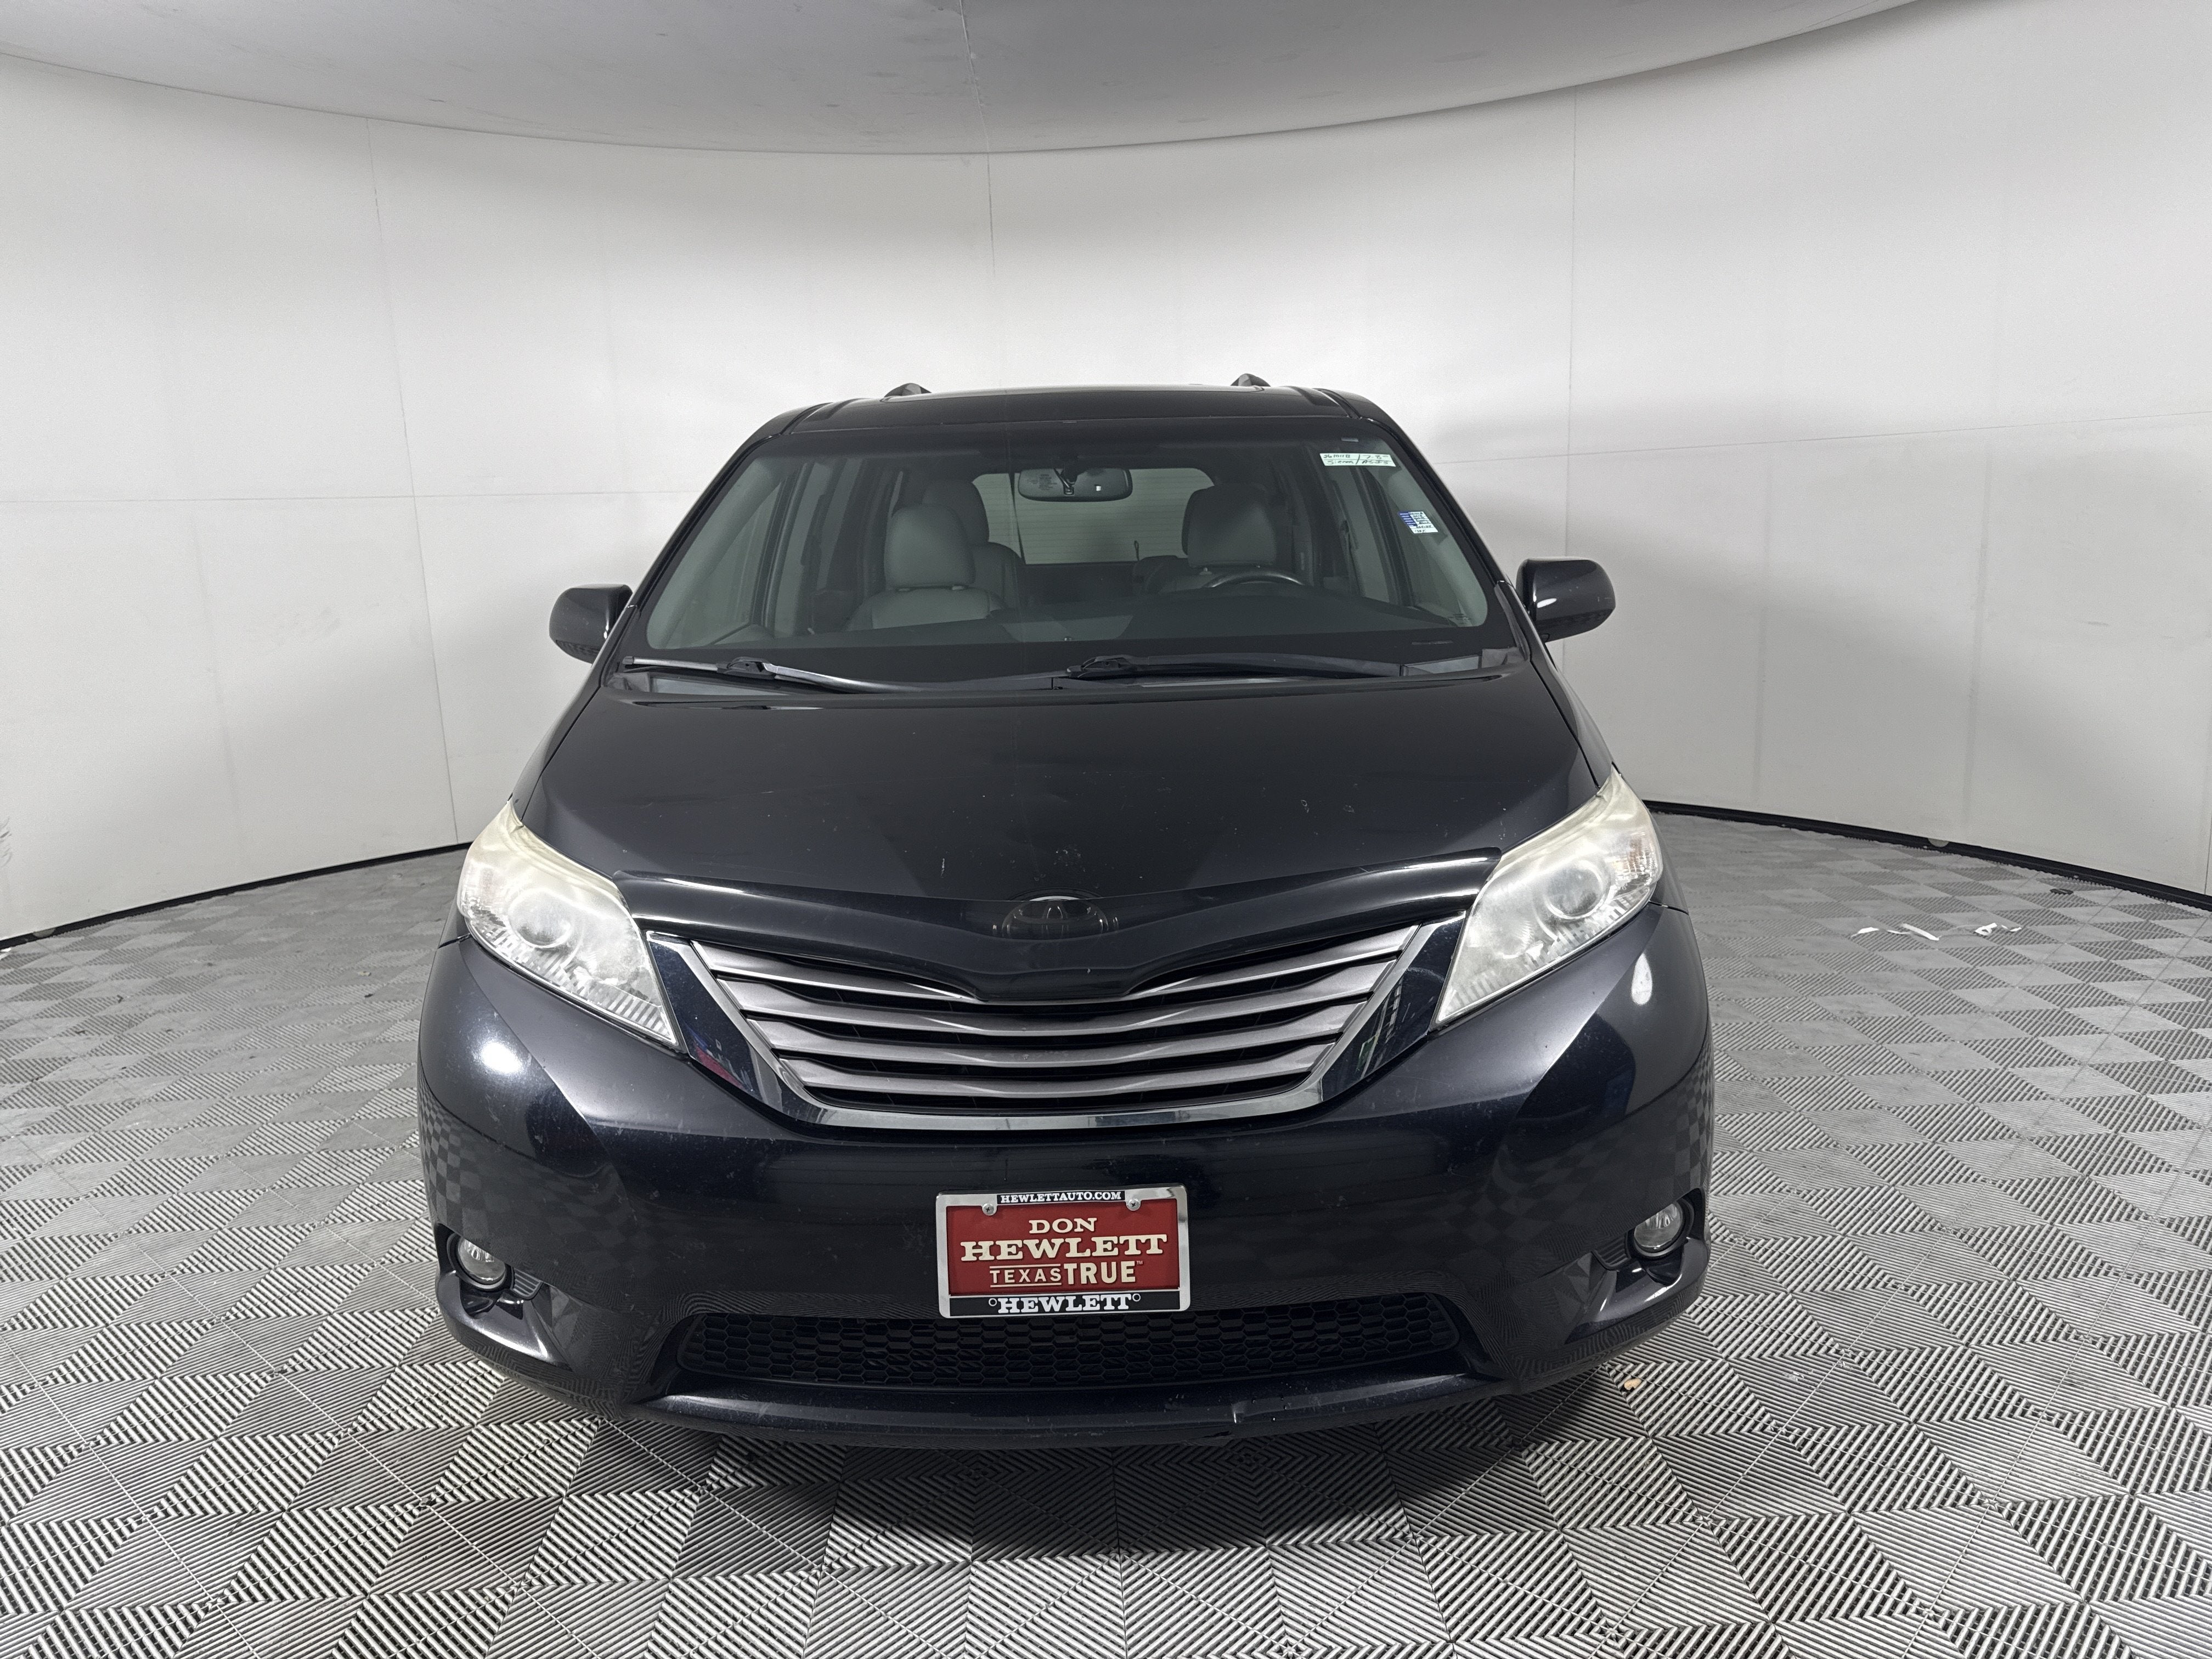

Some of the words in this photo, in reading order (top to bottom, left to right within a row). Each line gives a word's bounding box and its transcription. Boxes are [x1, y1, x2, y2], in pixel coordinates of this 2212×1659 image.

[1000, 1191, 1122, 1204] HEWLETTAUTO.COM
[1028, 1217, 1098, 1234] DON
[960, 1234, 1167, 1261] HEWLETT
[997, 1293, 1132, 1314] HEWLETT
